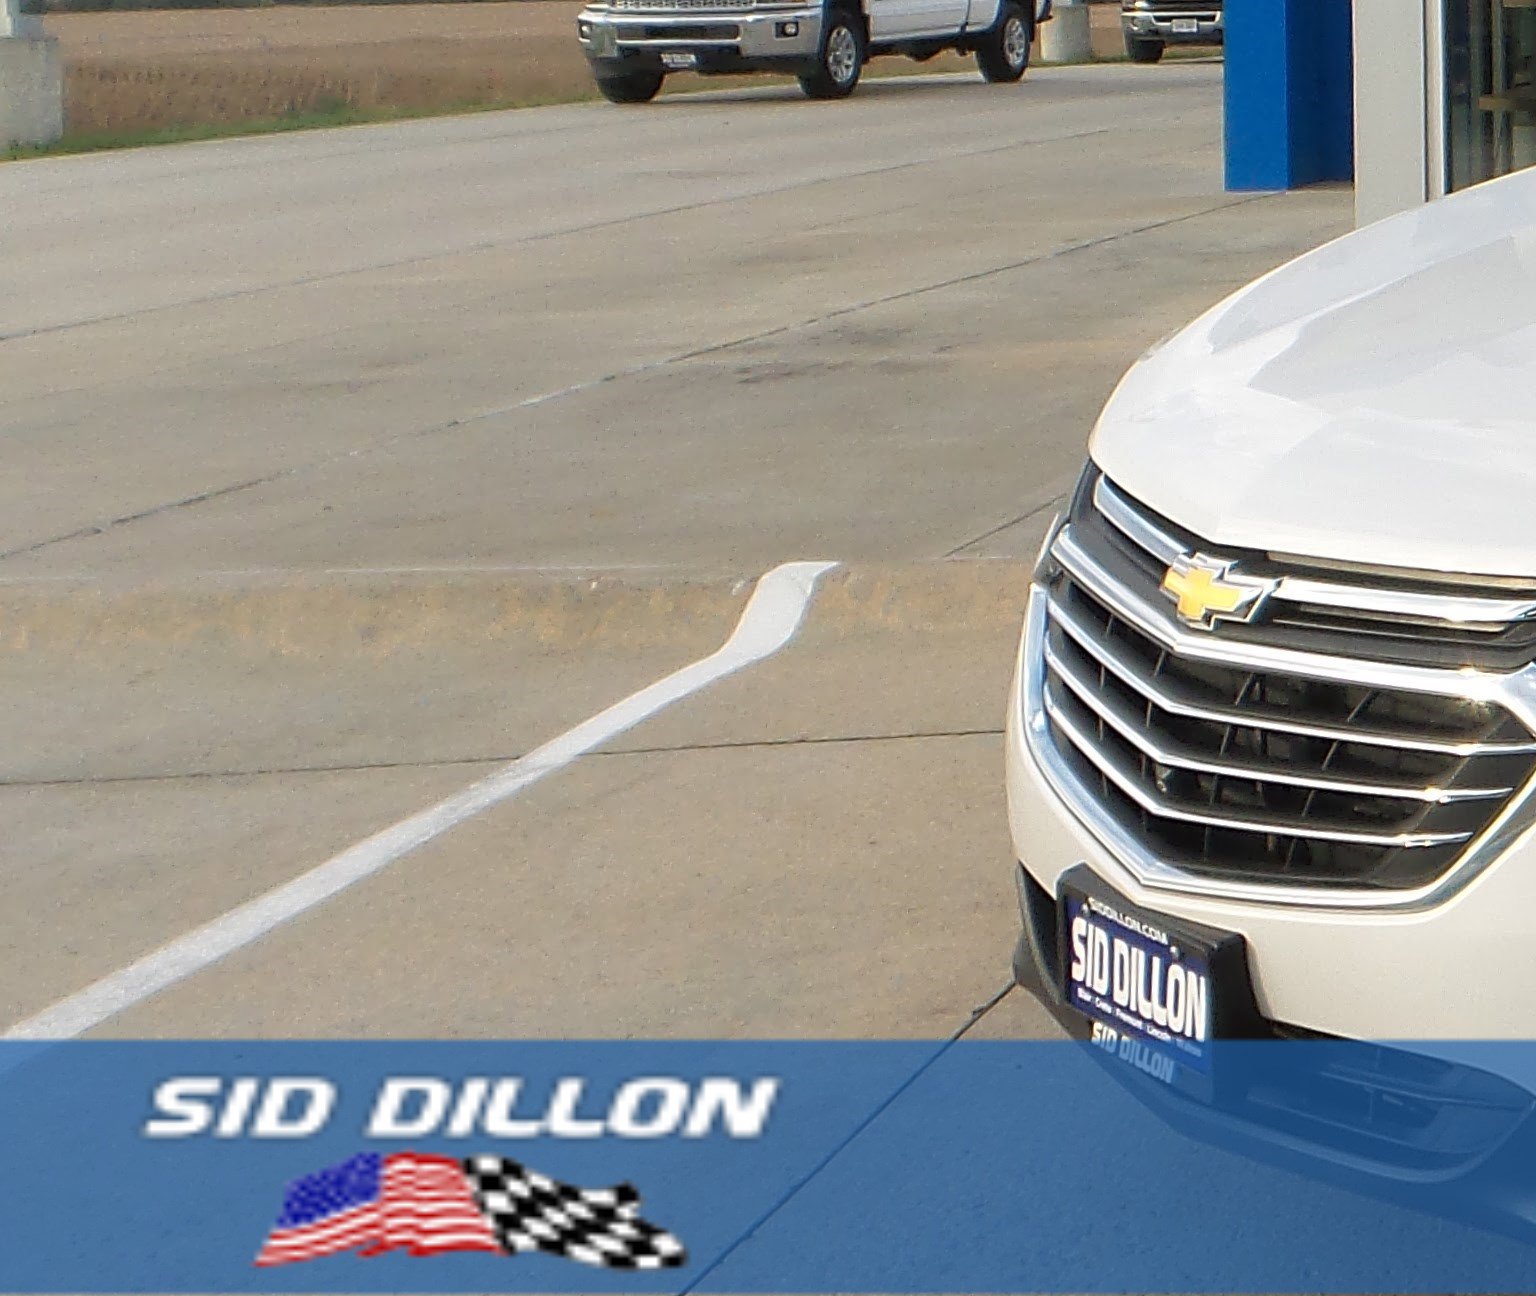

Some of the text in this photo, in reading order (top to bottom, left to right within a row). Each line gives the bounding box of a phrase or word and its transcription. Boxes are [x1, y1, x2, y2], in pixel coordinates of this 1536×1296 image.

[1070, 915, 1207, 1043] SID DILLON
[1091, 1021, 1119, 1055] SID
[1118, 1034, 1176, 1084] DILLON
